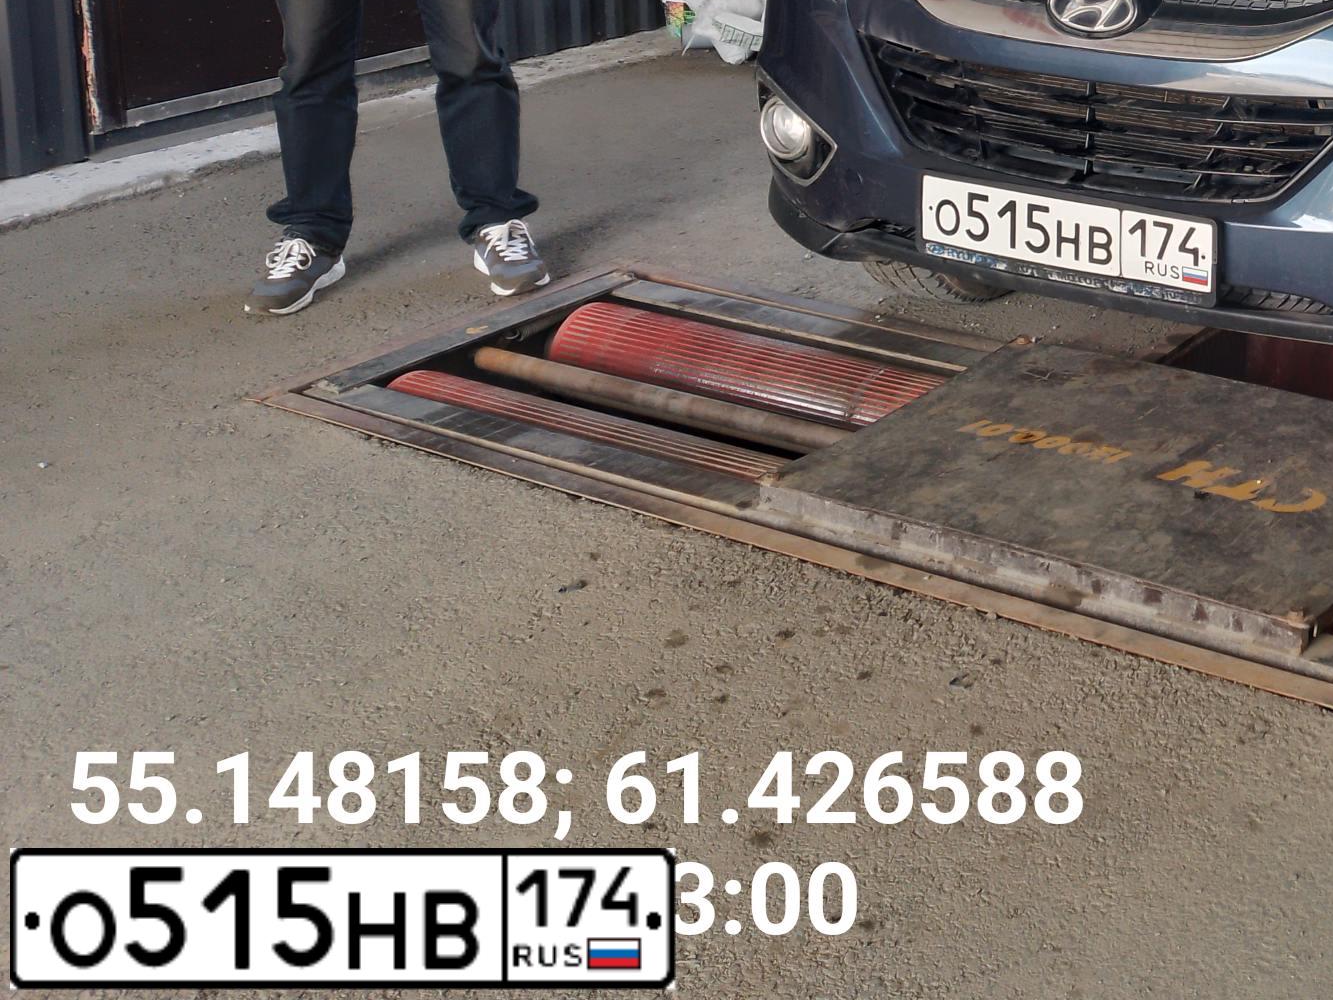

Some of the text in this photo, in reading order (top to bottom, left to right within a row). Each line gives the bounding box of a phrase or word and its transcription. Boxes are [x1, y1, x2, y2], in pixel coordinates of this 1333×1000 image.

[935, 191, 1200, 267] О515НВ 174
[1144, 260, 1181, 280] RUS
